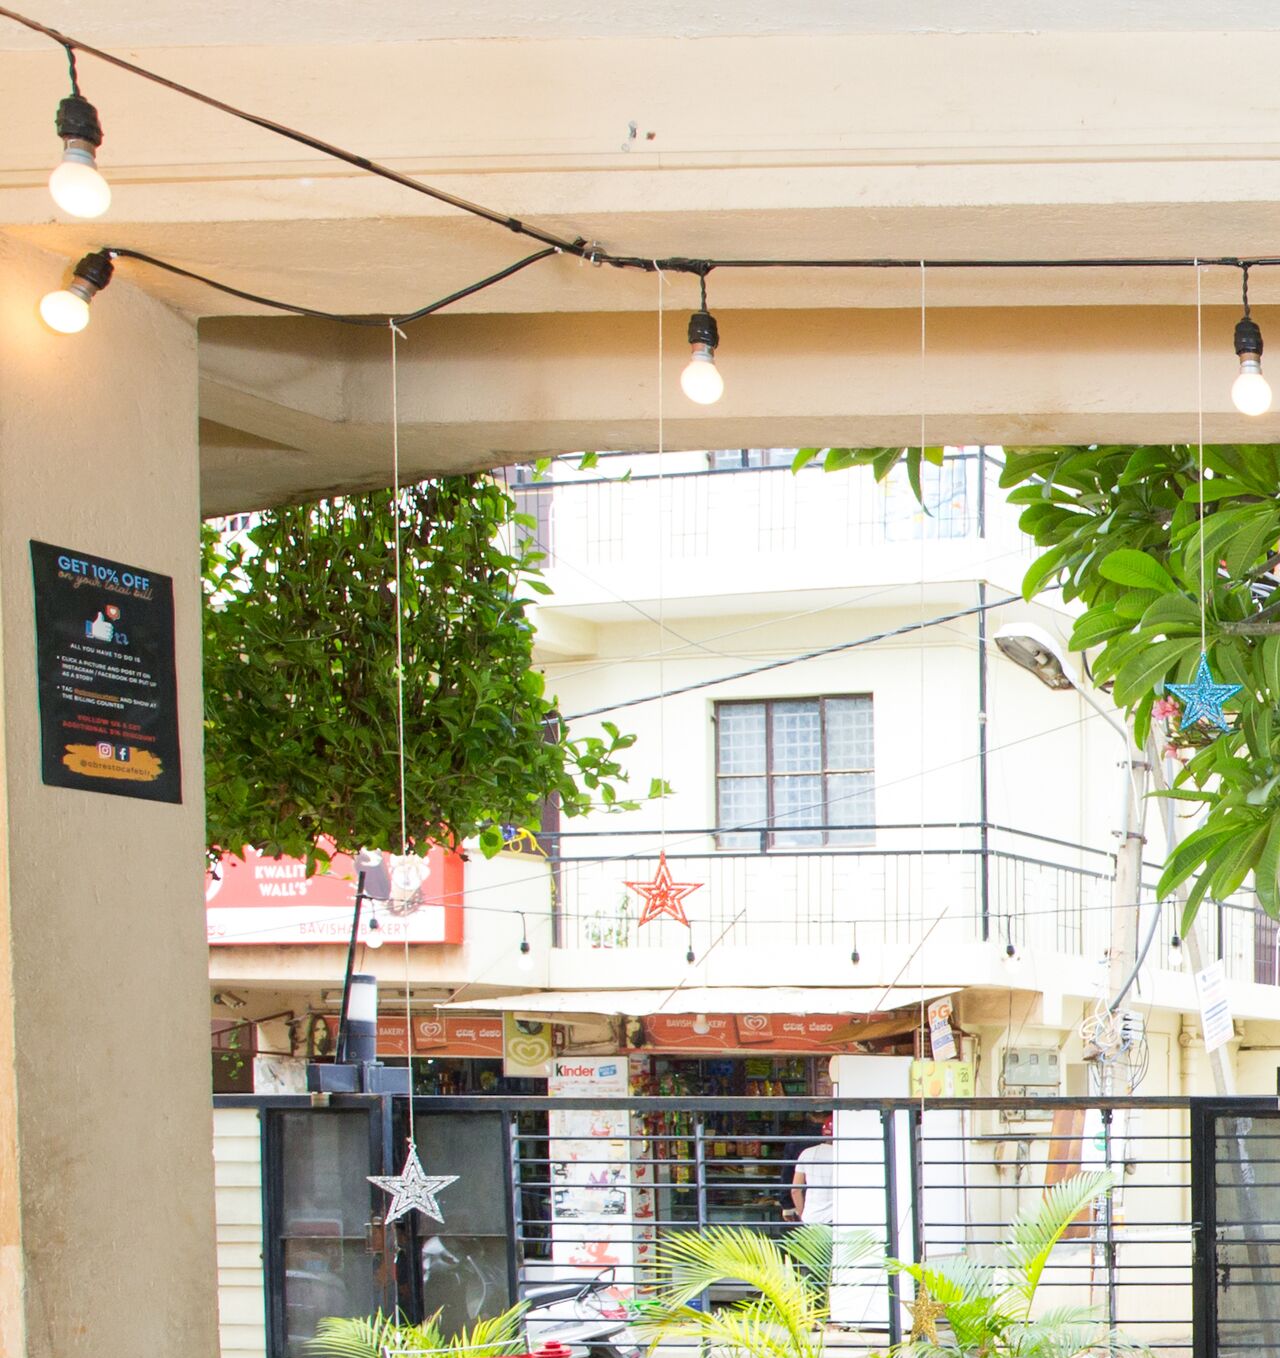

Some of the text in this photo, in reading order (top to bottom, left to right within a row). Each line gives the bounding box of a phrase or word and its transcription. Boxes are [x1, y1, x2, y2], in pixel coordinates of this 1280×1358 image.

[58, 556, 150, 591] GET 10% OFF
[70, 643, 81, 651] ALL
[82, 646, 95, 654] YOU
[255, 864, 307, 880] KWALIT
[259, 881, 308, 897] WALL'S
[666, 1019, 694, 1028] BAVISH
[379, 1027, 405, 1036] BAKERY
